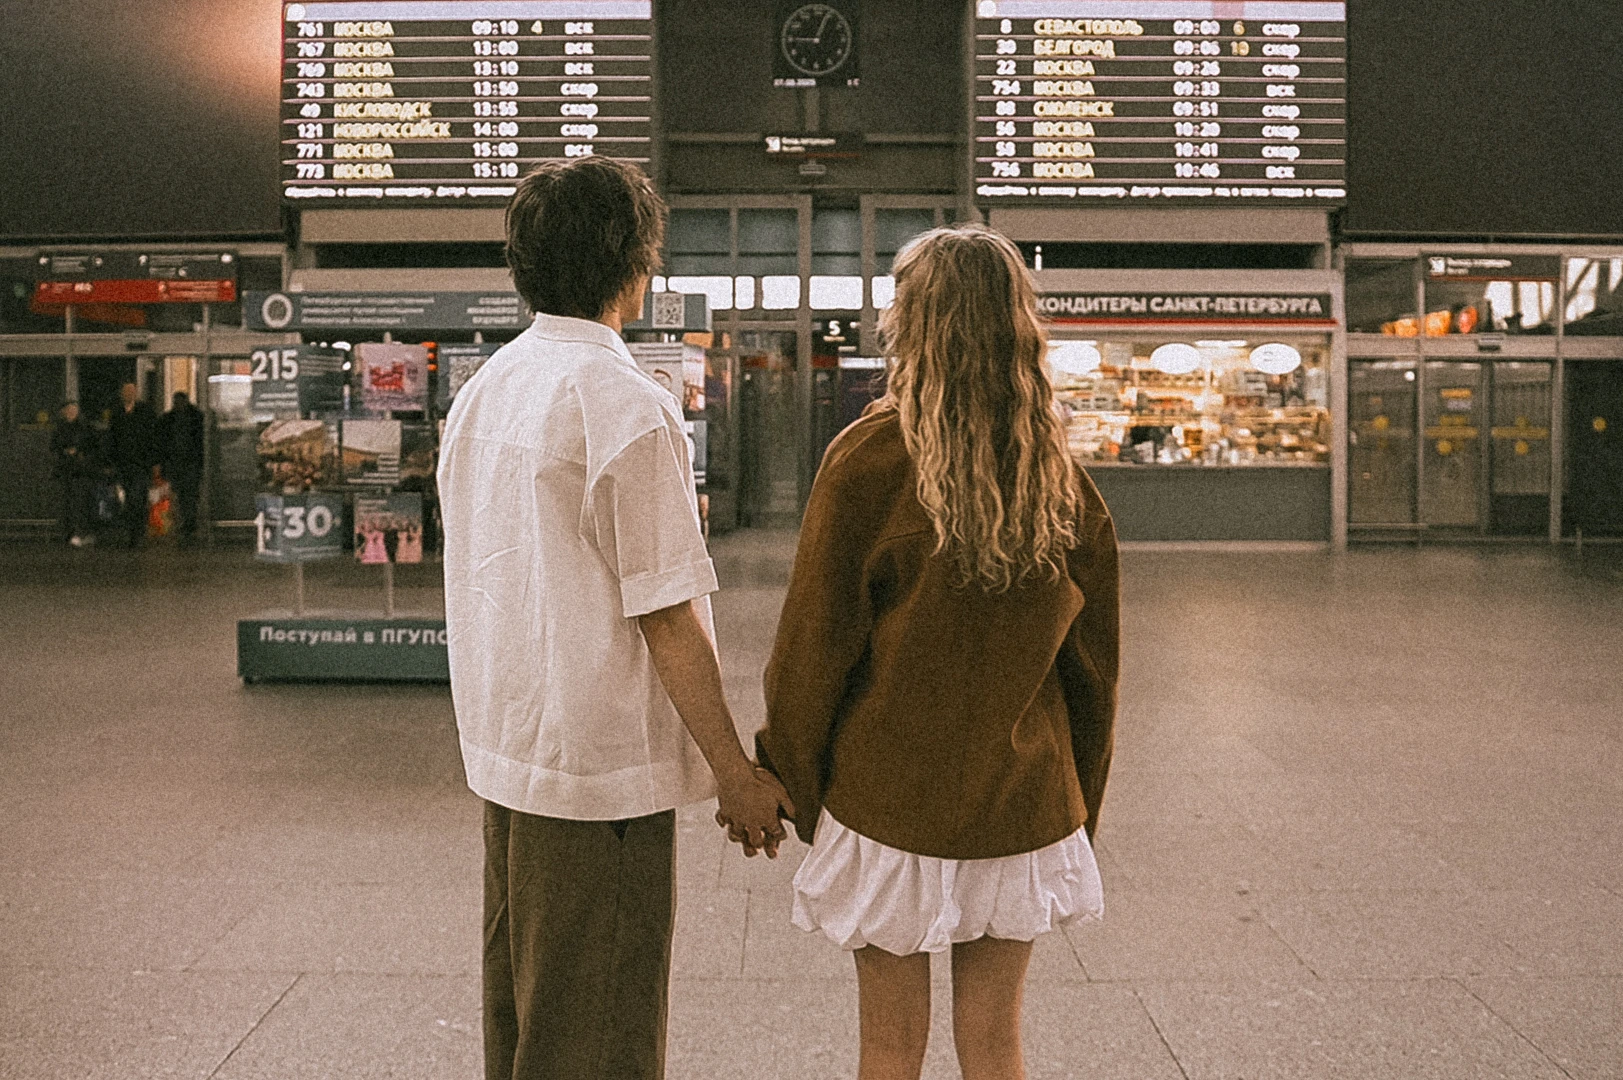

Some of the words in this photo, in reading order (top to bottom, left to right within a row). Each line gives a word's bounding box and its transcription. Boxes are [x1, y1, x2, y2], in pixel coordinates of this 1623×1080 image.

[334, 22, 394, 37] МОСКВА
[1034, 19, 1144, 35] СЕВАСТОПОЛЬ
[334, 42, 394, 57] МОСКВА
[1034, 39, 1116, 58] БЕЛГОРОД
[334, 62, 394, 77] МОСКВА
[1033, 60, 1095, 76] МОСКВА
[334, 83, 394, 98] МОСКВА
[1033, 81, 1095, 96] МОСКВА
[334, 102, 432, 121] КИСЛОВОДСК
[1033, 101, 1114, 117] СМОЛЕНСК
[334, 119, 451, 138] НОВОРОССИЙСК
[1033, 122, 1095, 137] МОСКВА
[334, 143, 394, 158] МОСКВА
[1033, 142, 1095, 157] МОСКВА
[334, 163, 394, 178] МОСКВА
[1033, 162, 1095, 178] МОСКВА
[1035, 297, 1146, 313] КОНДИТЕРЫ
[1150, 297, 1323, 314] САНКТ-ПЕТЕРБУРГА
[252, 349, 299, 381] 215
[259, 626, 357, 646] Поступай
[363, 631, 375, 644] в
